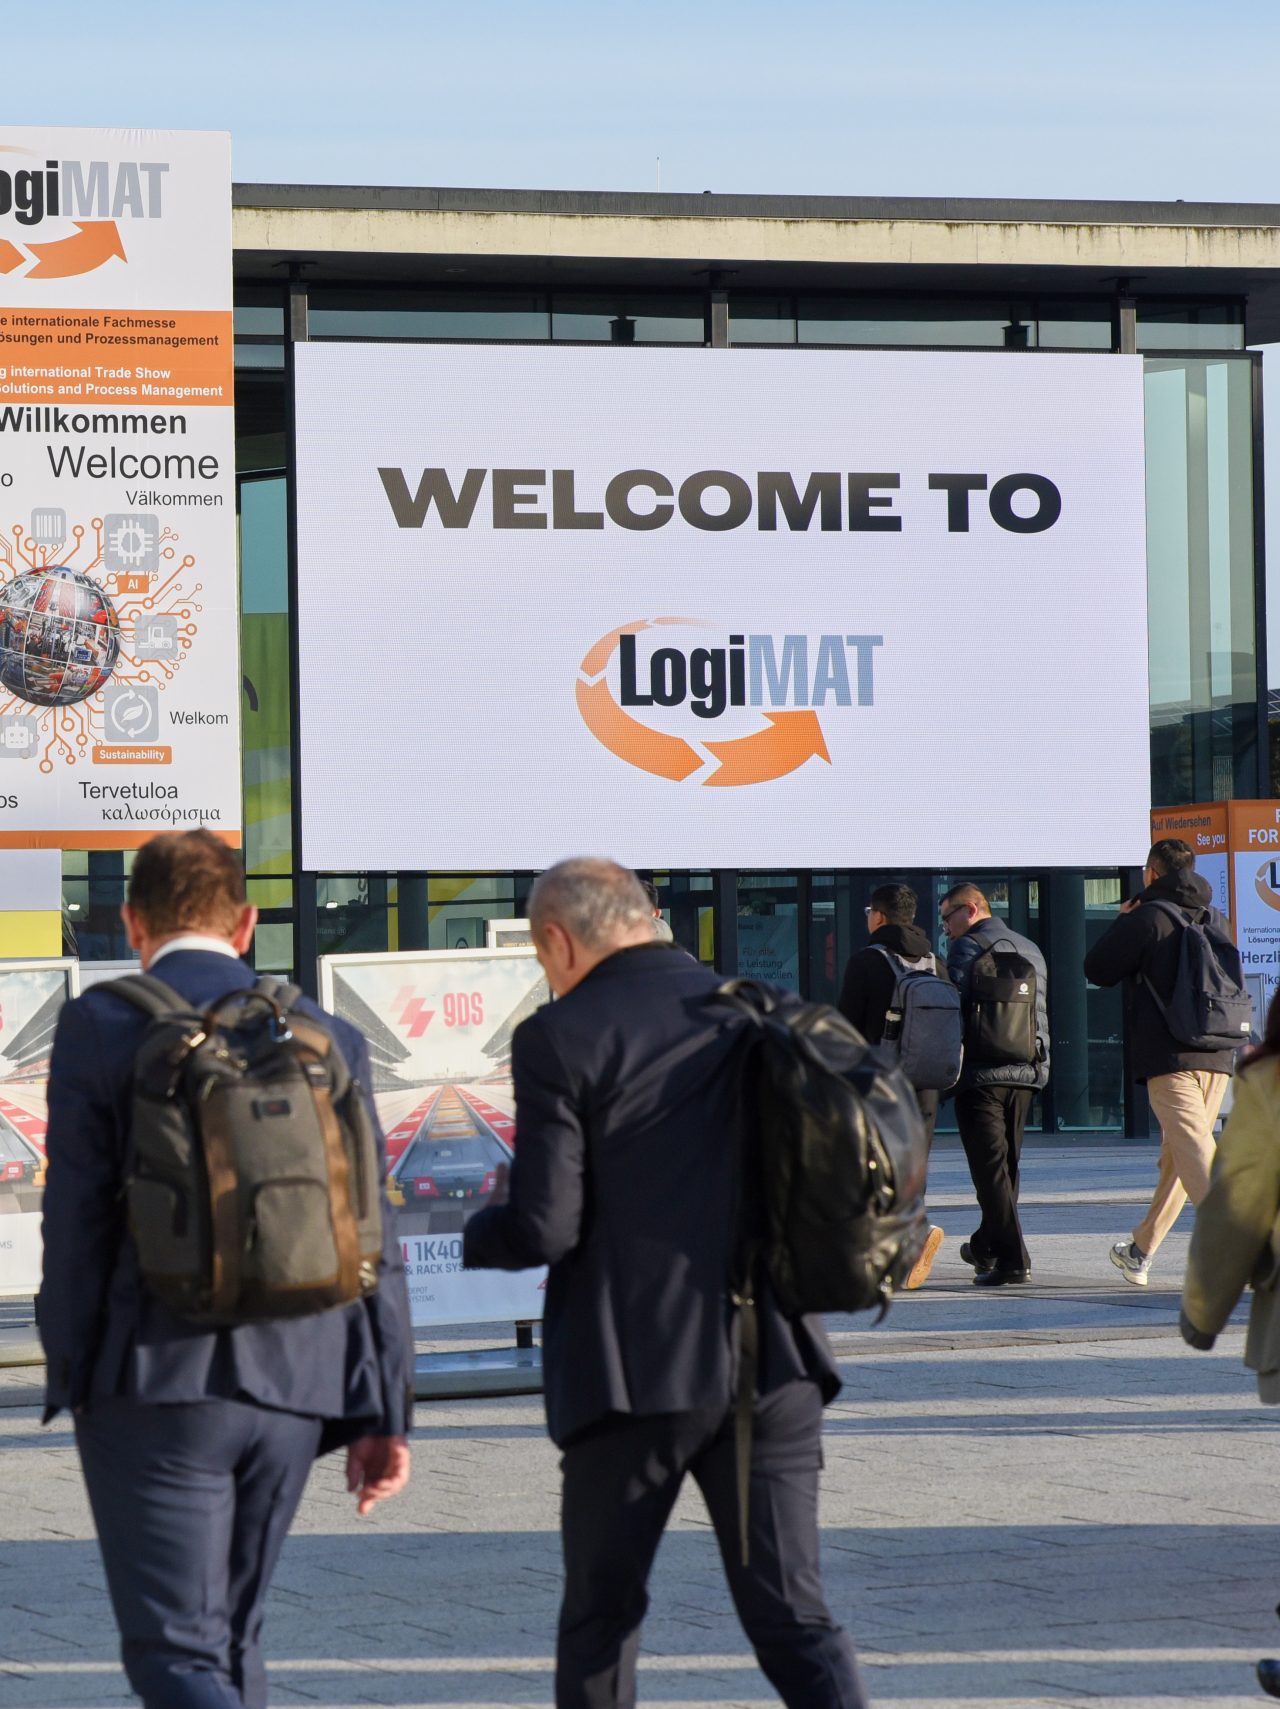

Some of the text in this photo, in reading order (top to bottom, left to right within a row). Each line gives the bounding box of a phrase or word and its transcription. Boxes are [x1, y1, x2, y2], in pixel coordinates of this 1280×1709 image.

[11, 315, 100, 328] internationale
[103, 316, 176, 329] Fachmesse
[57, 332, 82, 345] und
[86, 333, 219, 348] Prozessmanagement
[11, 366, 92, 379] international
[95, 367, 132, 380] Trade
[135, 367, 171, 380] Show
[58, 383, 82, 395] and
[86, 383, 137, 396] Process
[141, 384, 223, 399] Management
[47, 446, 220, 481] Welcome
[126, 490, 223, 507] Välkommen
[377, 467, 1062, 534] WELCOME TO
[128, 578, 139, 590] AI
[619, 633, 884, 719] LogiMAT
[170, 711, 229, 725] Welkom
[99, 749, 166, 763] Sustainability
[79, 781, 179, 799] Tervetuloa
[1166, 815, 1212, 830] Wiedersehen
[1197, 833, 1226, 849] See you
[1248, 828, 1279, 844] FOR
[414, 1239, 464, 1262] 1K40
[417, 1263, 442, 1276] RACK
